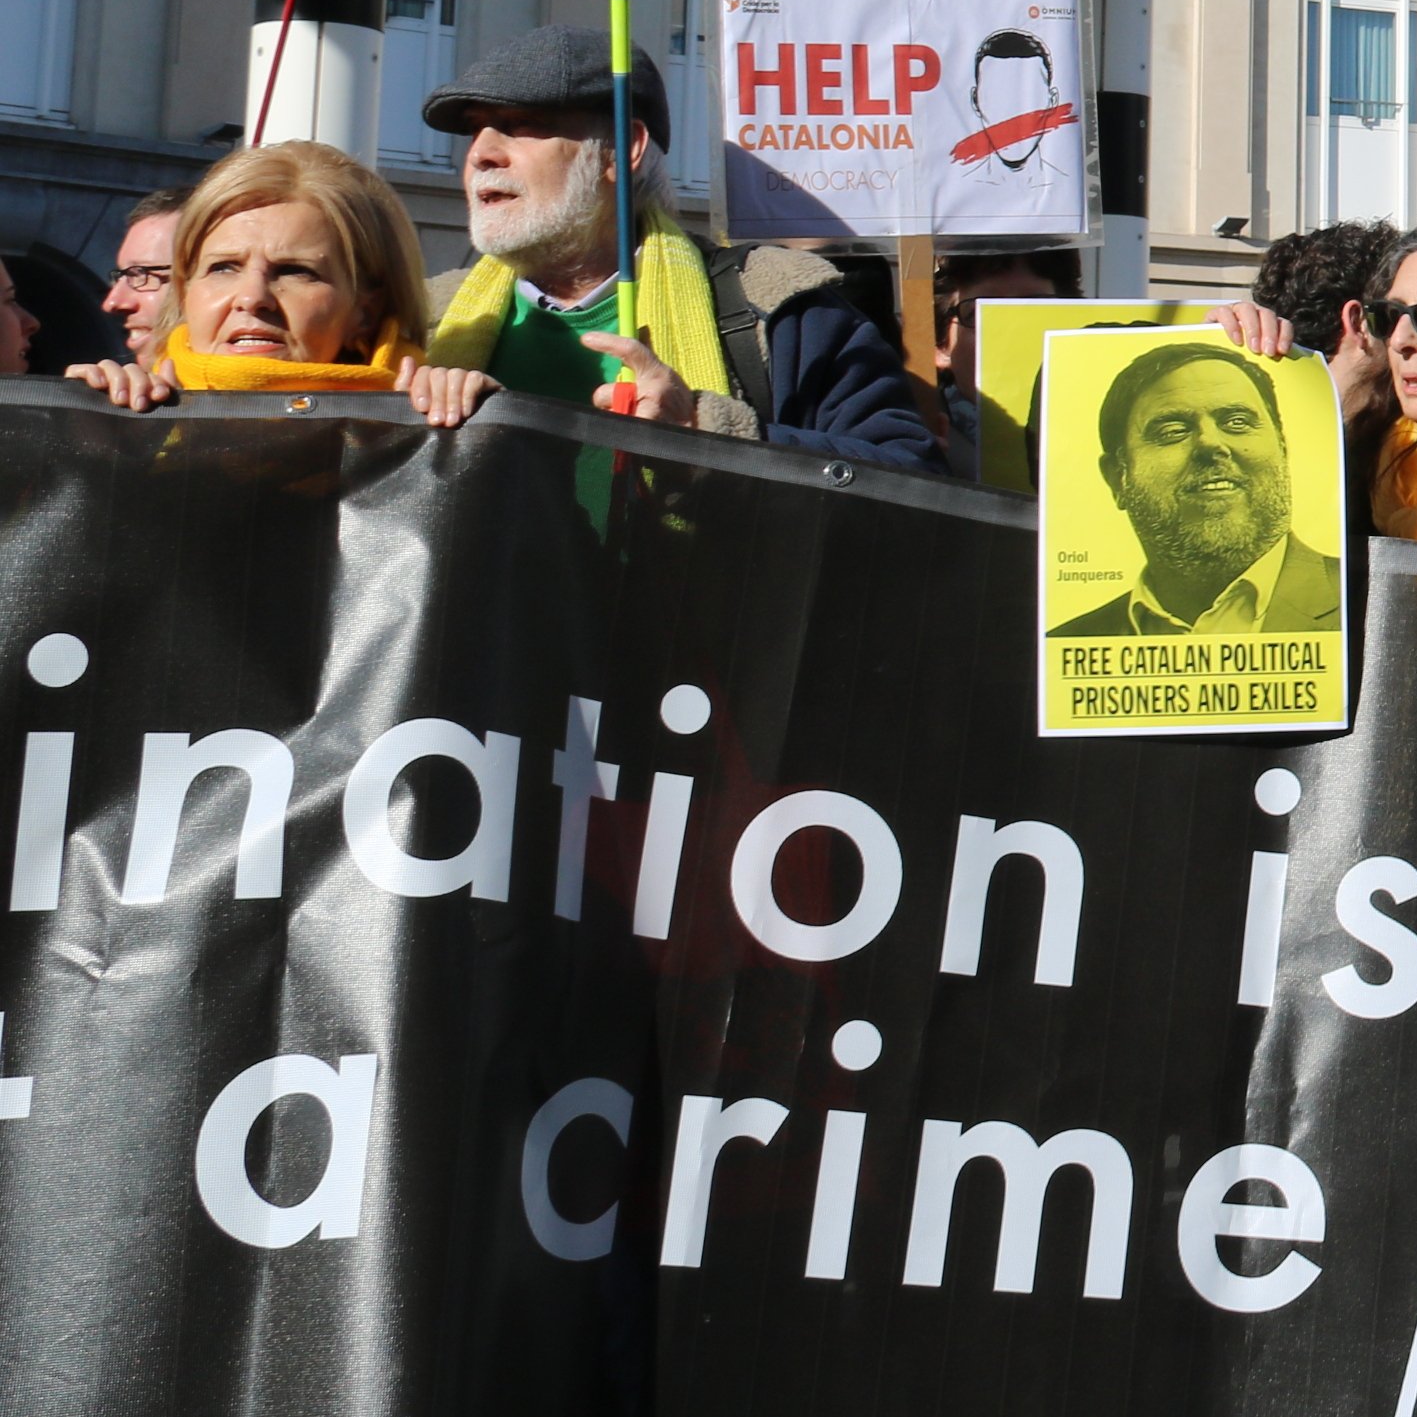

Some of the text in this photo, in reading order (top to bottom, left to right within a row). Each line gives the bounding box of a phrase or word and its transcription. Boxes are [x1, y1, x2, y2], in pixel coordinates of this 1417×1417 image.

[737, 42, 942, 115] HELP
[738, 123, 914, 151] CATALONIA
[766, 168, 899, 192] DEMOCRACY
[1057, 551, 1088, 564] Oriol
[1056, 568, 1124, 583] Junqueras
[1062, 642, 1326, 676] FREE CATALAN POLITICAL
[1072, 681, 1318, 716] PRISONERS AND EXILES
[9, 633, 1085, 988] ination
[195, 1053, 378, 1250] a
[520, 1020, 1328, 1315] crime
